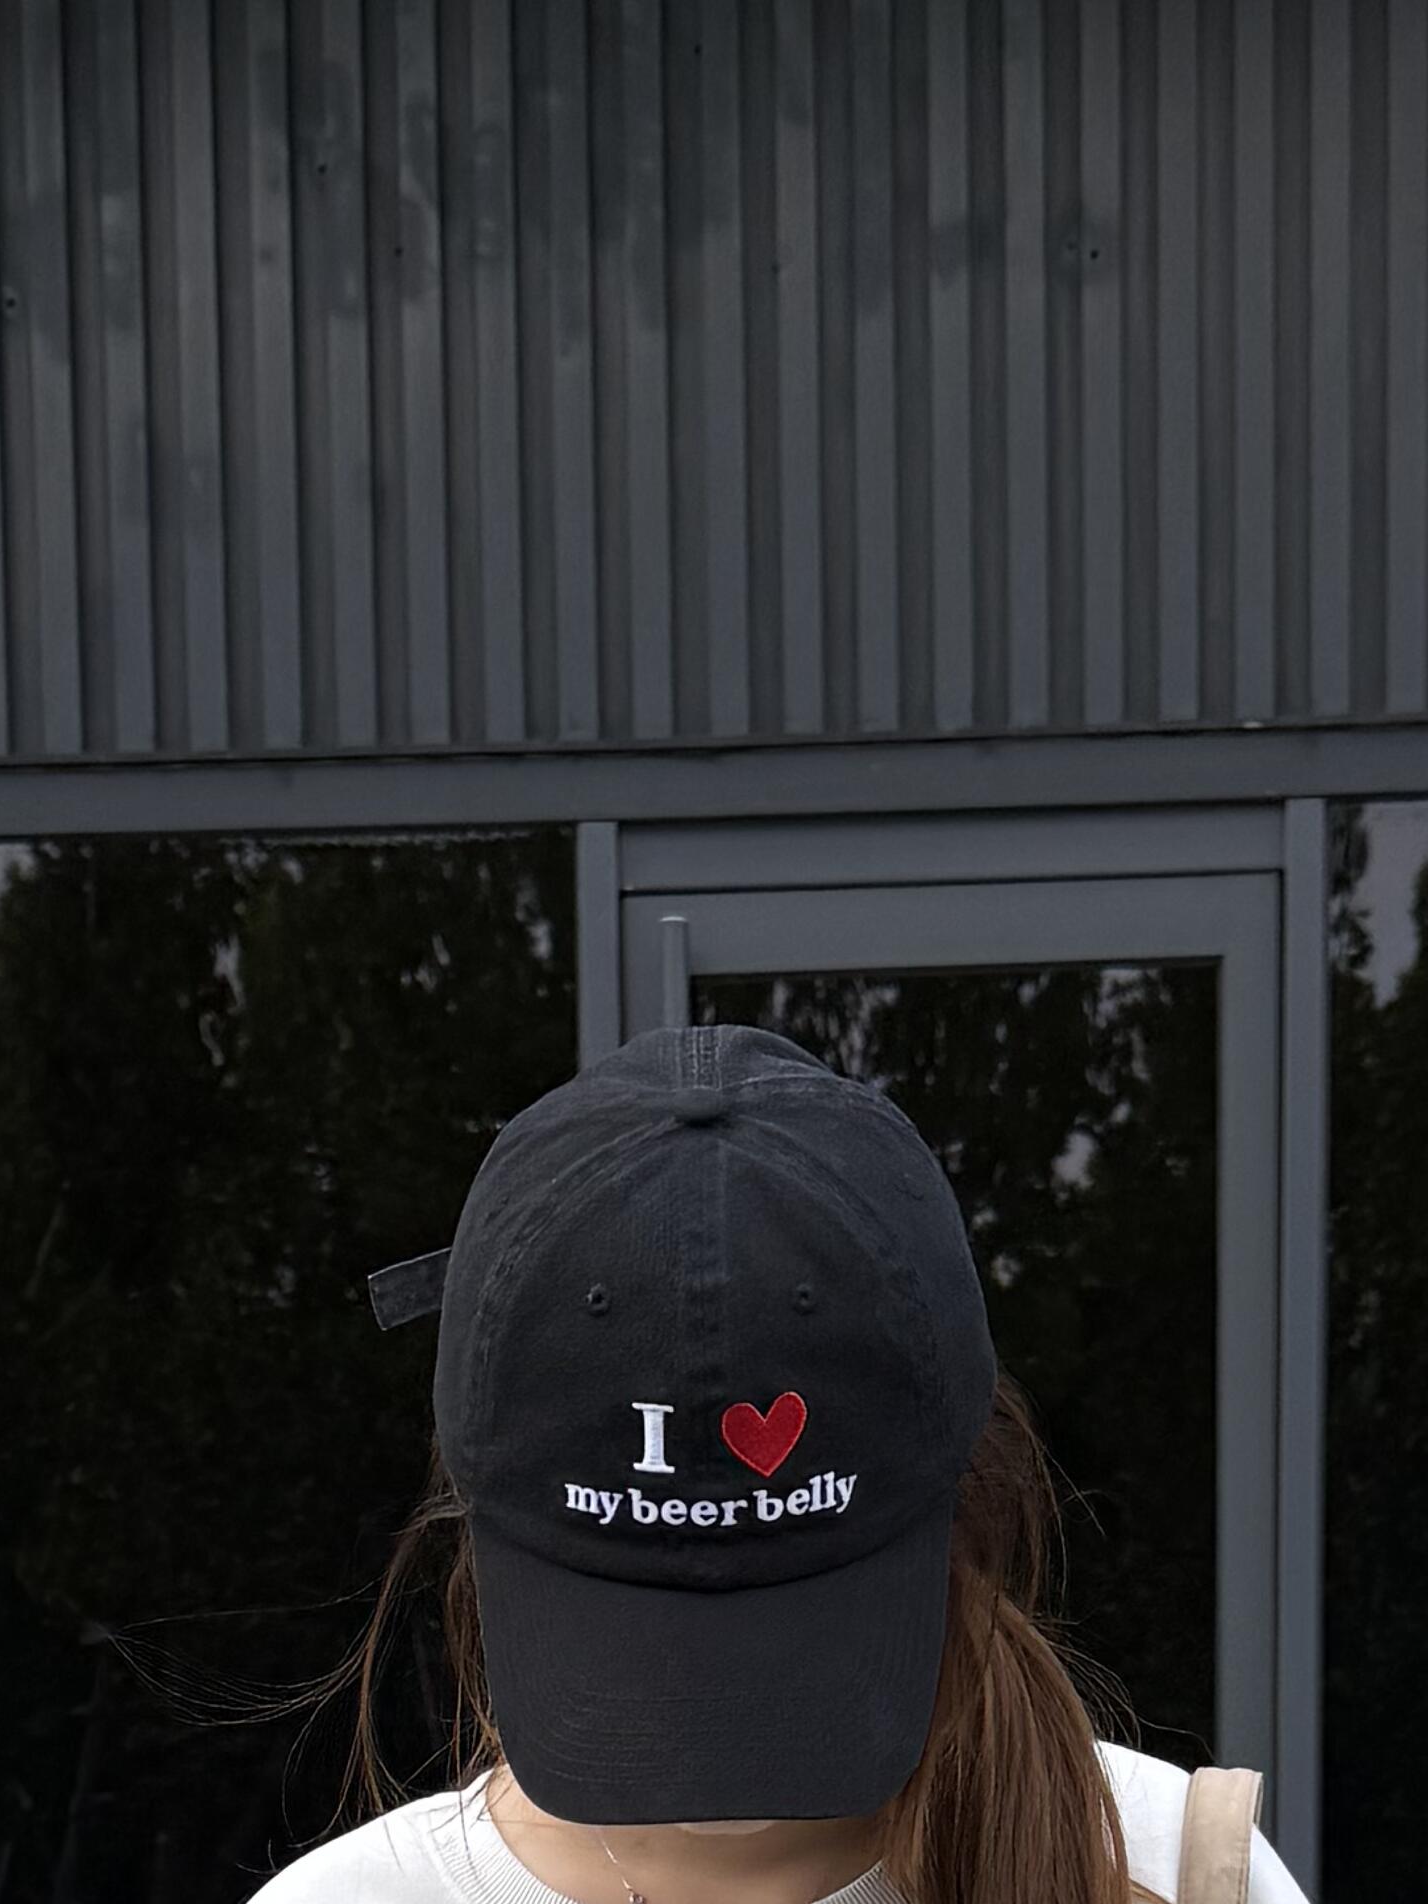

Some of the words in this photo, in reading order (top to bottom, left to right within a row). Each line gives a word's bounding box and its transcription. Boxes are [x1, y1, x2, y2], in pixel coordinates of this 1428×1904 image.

[632, 1402, 675, 1474] I
[565, 1483, 624, 1525] my
[628, 1488, 748, 1526] beer
[753, 1471, 857, 1523] belly
